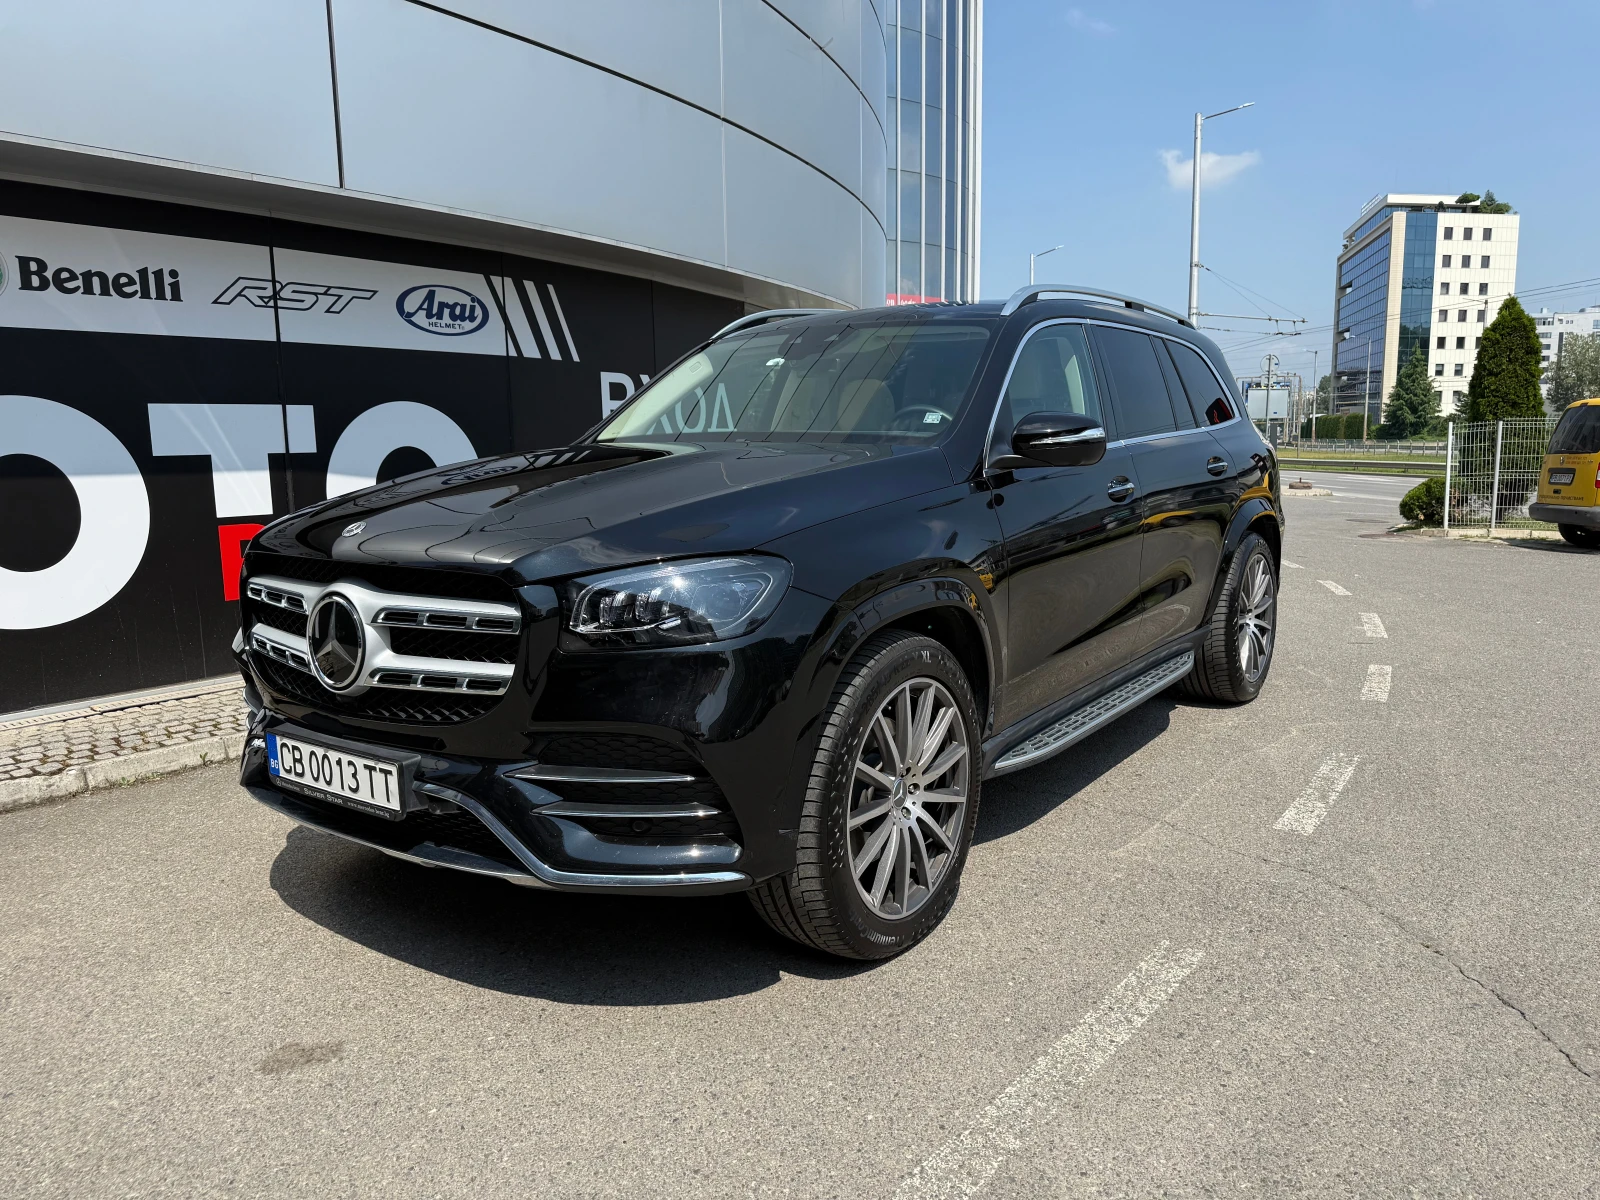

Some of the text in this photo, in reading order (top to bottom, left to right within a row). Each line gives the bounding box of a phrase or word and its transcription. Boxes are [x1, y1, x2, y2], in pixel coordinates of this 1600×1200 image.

[15, 255, 183, 302] Benelli
[211, 276, 379, 314] RST
[403, 289, 479, 323] Arai
[270, 758, 279, 769] BG
